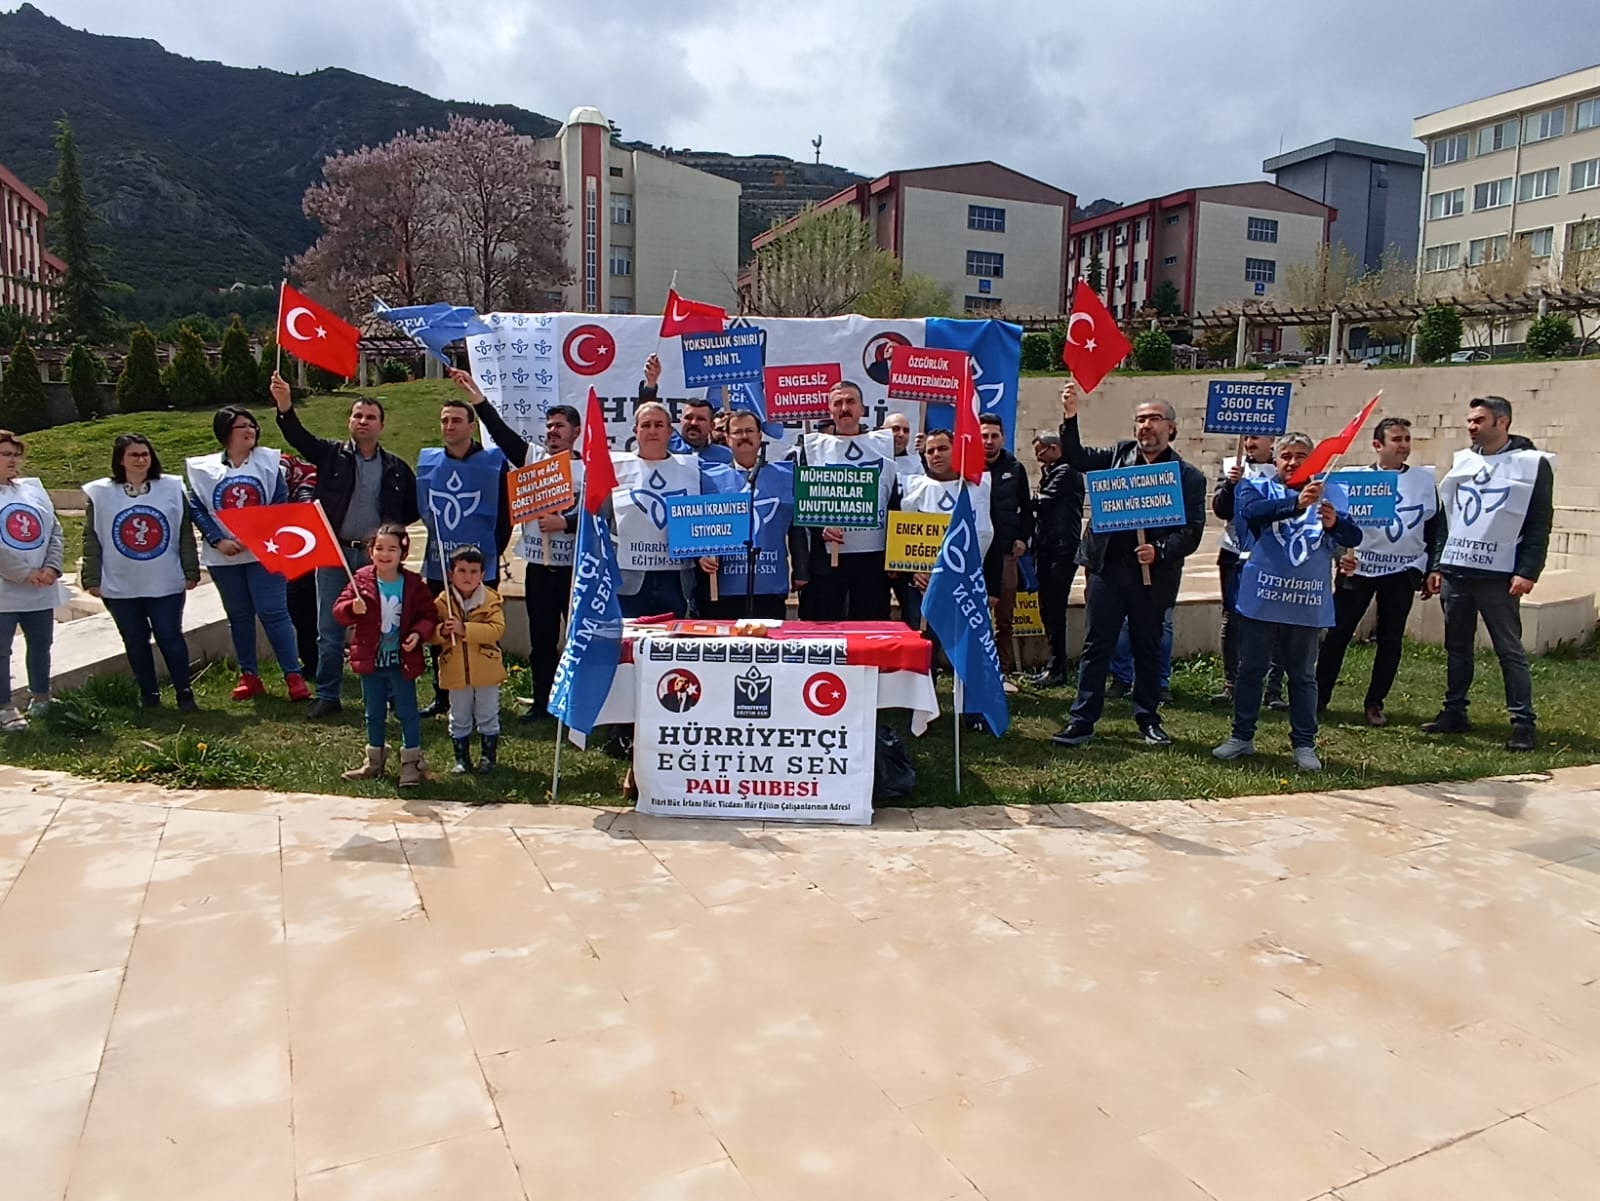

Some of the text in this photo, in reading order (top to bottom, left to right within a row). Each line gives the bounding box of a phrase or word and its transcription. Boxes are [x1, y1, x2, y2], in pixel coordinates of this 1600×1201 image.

[683, 333, 758, 351] YOKSULLUK SINIRI
[703, 351, 742, 367] 30 BİN TL
[908, 355, 949, 371] ÖZGÜRLÜK
[778, 372, 828, 387] ENGELSİZ
[892, 373, 959, 389] KARAKTERİMİZDİR
[1214, 384, 1285, 396] 1. DERECEYE
[774, 390, 829, 406] ÜNİVERSİT
[1221, 397, 1274, 410] 3600 EK
[1216, 411, 1275, 423] GÖSTERGE
[800, 468, 873, 483] MÜHENDİSLER
[535, 482, 570, 502] İSTİYORUZ
[809, 483, 863, 498] MİMARLAR
[1364, 482, 1393, 496] DEĞİL
[672, 499, 749, 517] BAYRAM İKRAMİYESİ
[799, 500, 873, 513] UNUTULMASIN
[1124, 496, 1140, 510] HÜR
[1141, 492, 1172, 509] SENDİKA
[691, 523, 732, 537] İSTİYORUZ
[896, 523, 924, 535] EMEK
[926, 524, 939, 536] EN
[905, 543, 940, 557] DEĞER
[658, 722, 848, 754] HÜRRİYETÇİ
[657, 749, 849, 775] EĞİTİM SEN
[685, 774, 819, 800] PAÜ ŞUBESİ
